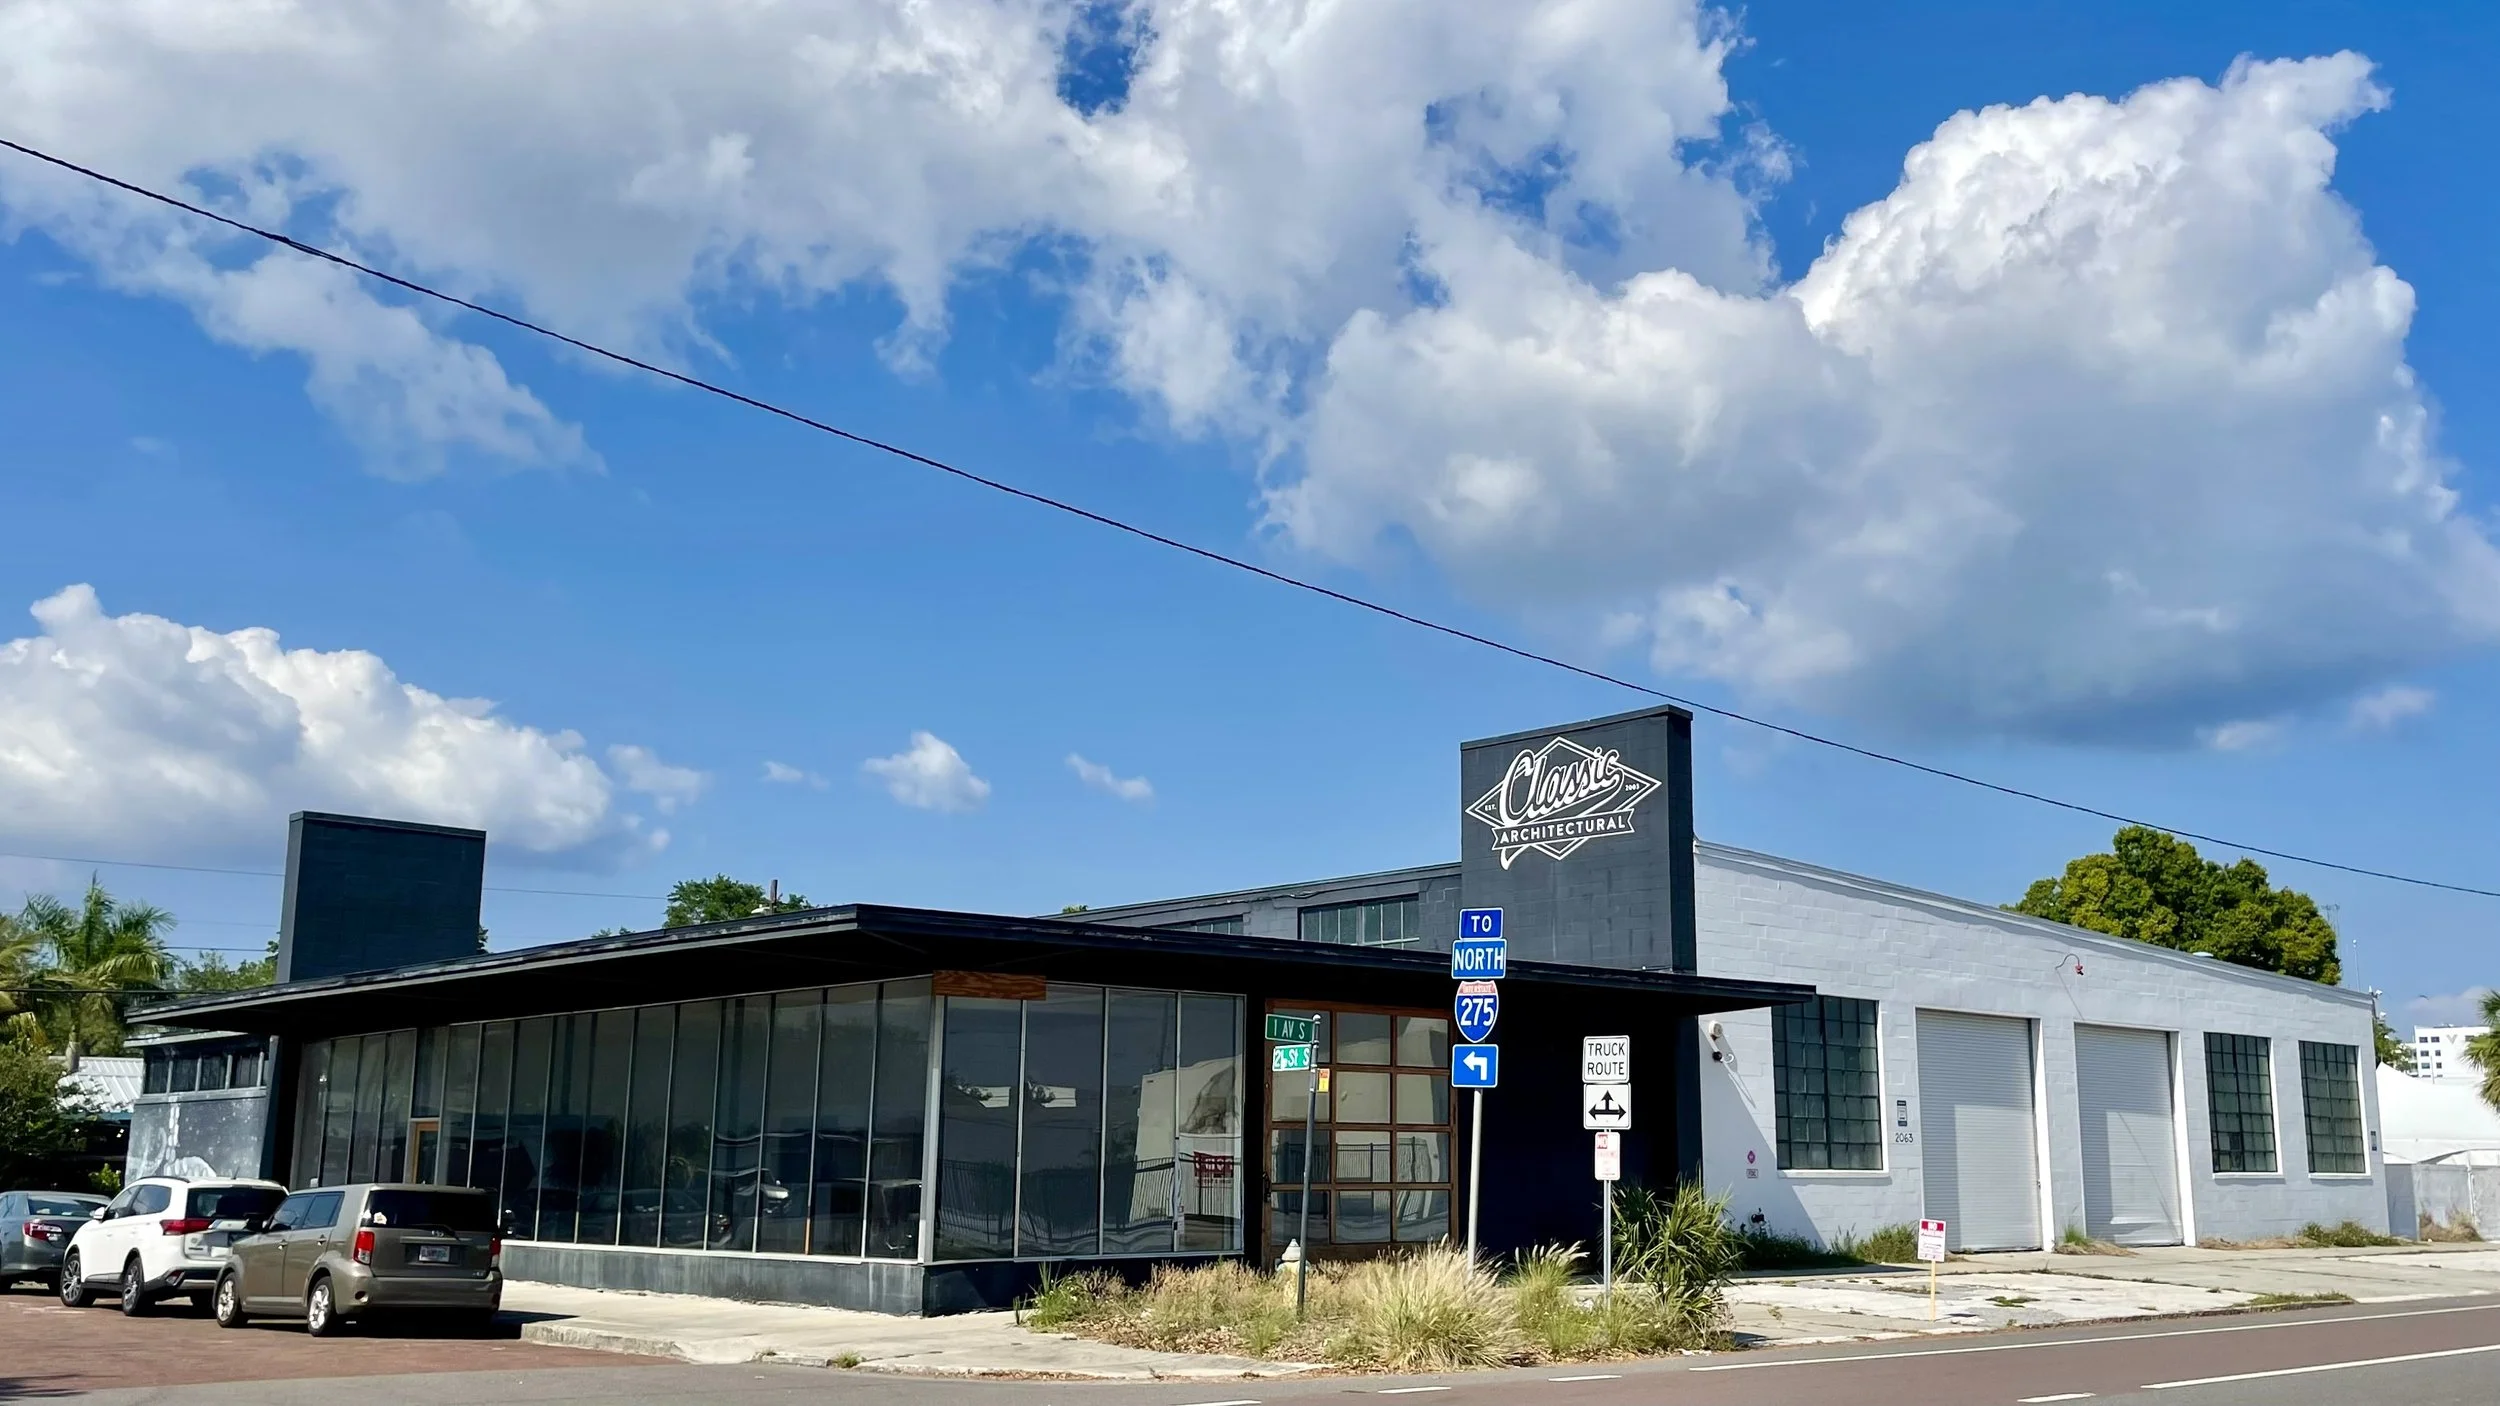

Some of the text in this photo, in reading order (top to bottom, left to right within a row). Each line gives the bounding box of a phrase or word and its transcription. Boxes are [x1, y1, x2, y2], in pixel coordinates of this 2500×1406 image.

[1499, 746, 1625, 827] Classic
[1500, 815, 1626, 844] ARCHITECTURAL
[1471, 915, 1492, 932] TO
[1454, 947, 1504, 971] NORTH
[1460, 998, 1495, 1026] 275
[1282, 1020, 1294, 1038] AV
[1299, 1022, 1306, 1040] S
[1303, 1048, 1310, 1066] S
[1587, 1042, 1626, 1056] TRUCK
[1587, 1061, 1625, 1075] ROUTE
[1895, 1132, 1914, 1143] 2063
